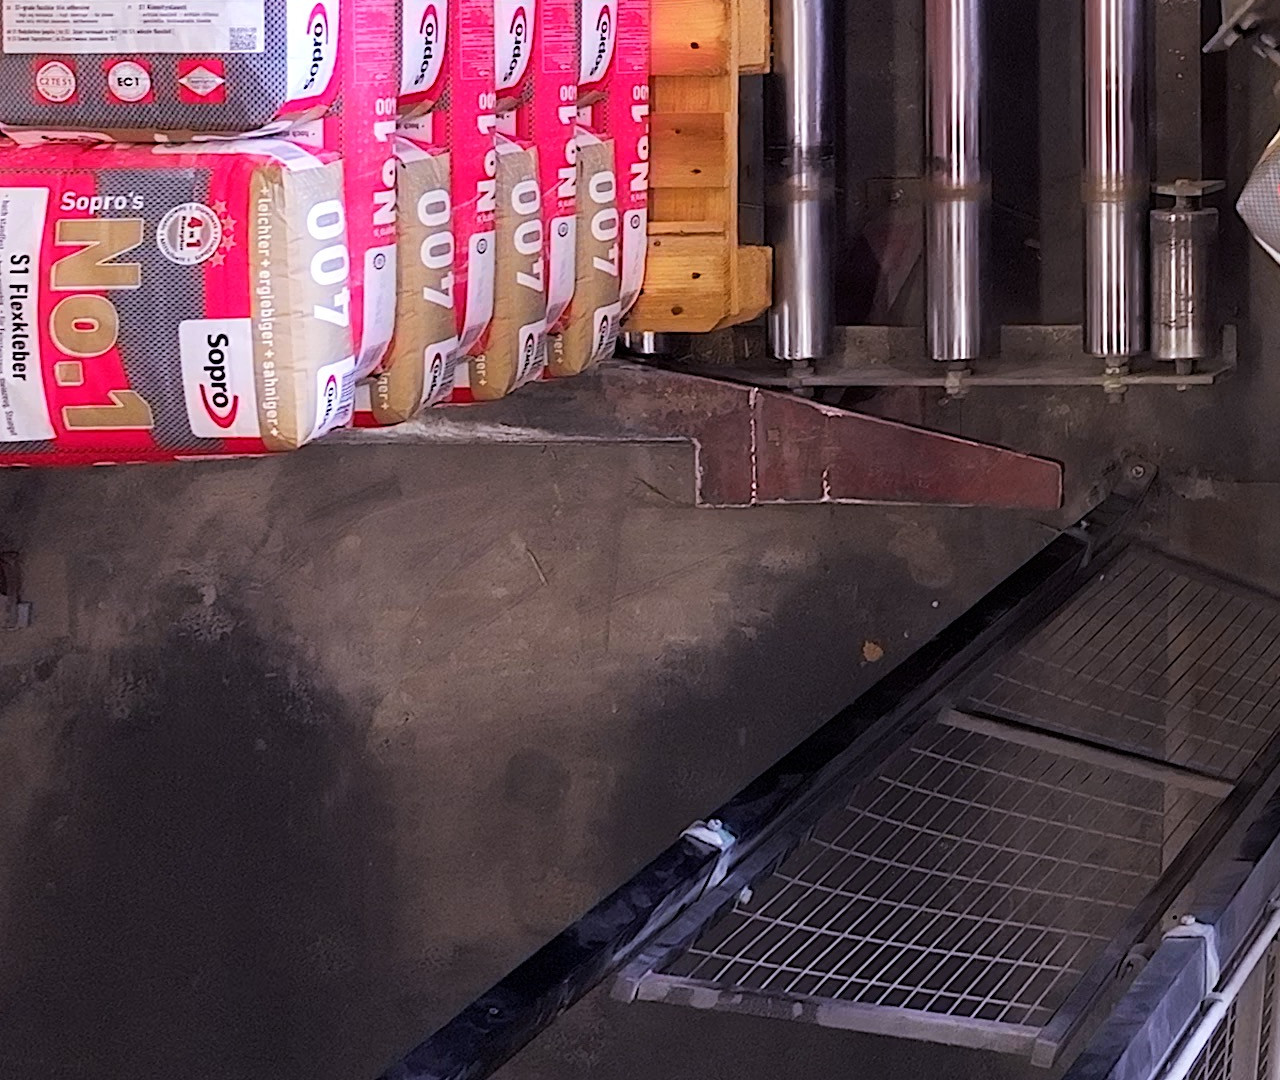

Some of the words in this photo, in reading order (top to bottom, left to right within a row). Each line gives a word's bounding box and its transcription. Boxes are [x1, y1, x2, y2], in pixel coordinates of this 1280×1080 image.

[304, 22, 324, 90] Sopro
[414, 22, 435, 86] Sopro
[503, 22, 524, 82] Sopro
[589, 20, 608, 77] Sopro
[478, 93, 496, 110] 00
[560, 85, 577, 101] 00
[633, 85, 649, 101] 00
[373, 120, 396, 226] No1
[477, 114, 496, 213] No1
[558, 106, 577, 198] No1
[60, 191, 144, 214] Sopro's
[256, 198, 273, 257] leichter
[511, 179, 544, 293] 400
[589, 171, 619, 277] 400
[9, 254, 30, 275] S1
[306, 199, 351, 328] 400
[417, 188, 455, 309] 400
[9, 284, 30, 381] Flexkleber
[50, 219, 154, 431] No.1
[256, 269, 276, 353] ergiebiger
[203, 333, 229, 408] Sopro
[262, 360, 280, 426] sahniger
